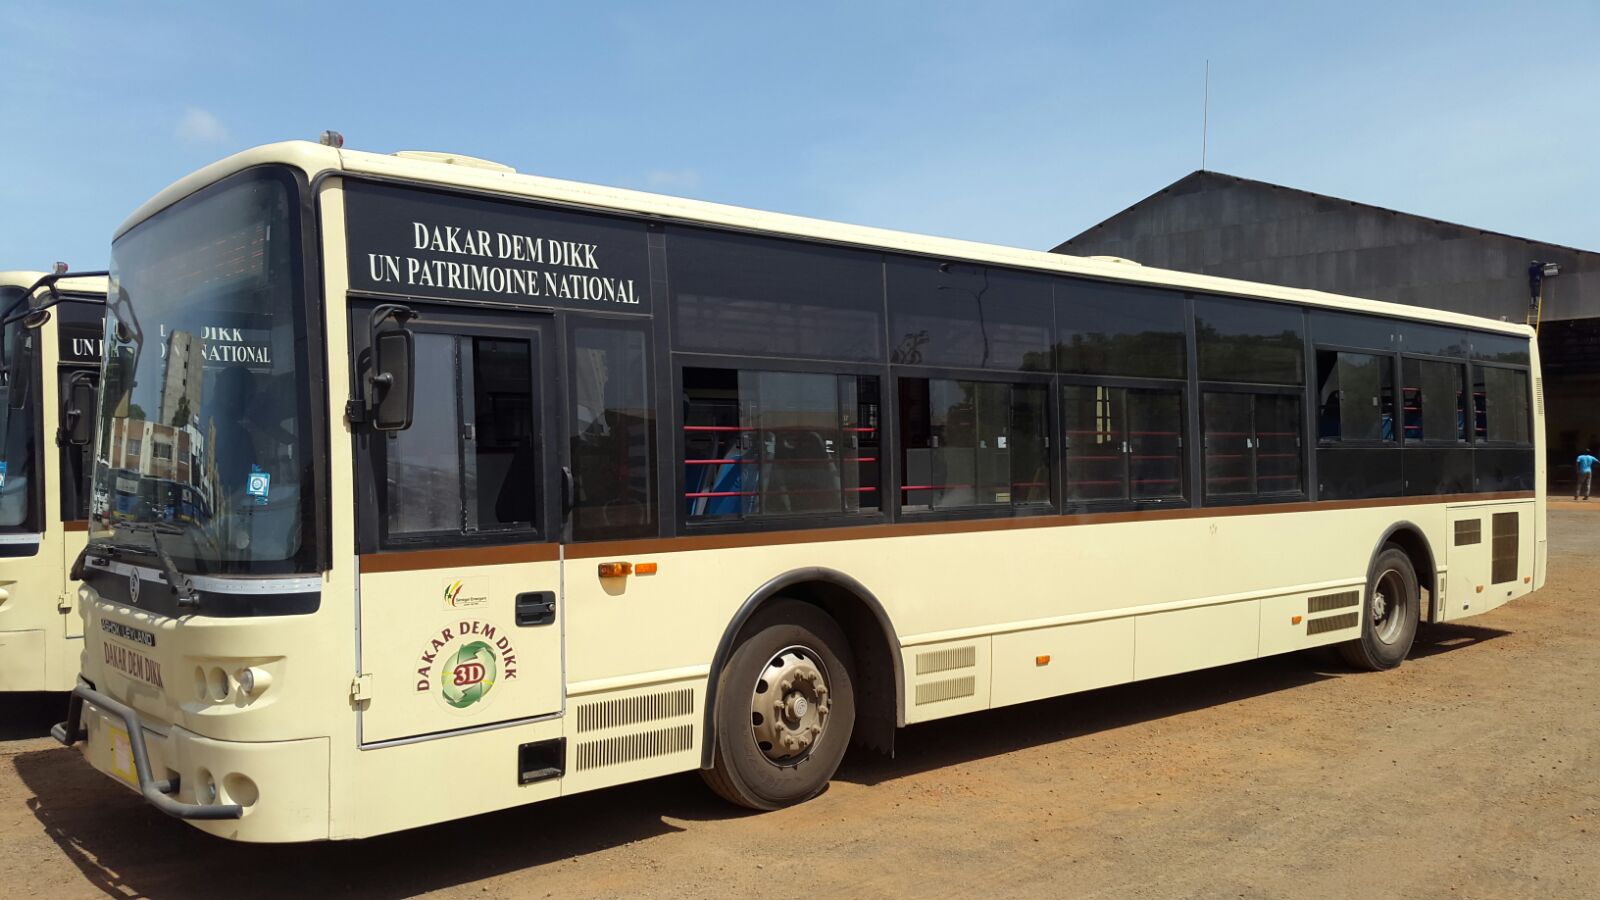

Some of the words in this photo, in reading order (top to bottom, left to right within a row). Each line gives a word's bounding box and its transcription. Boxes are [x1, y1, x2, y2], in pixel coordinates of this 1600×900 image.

[413, 221, 494, 258] DAKAR
[497, 232, 545, 264] DEM
[548, 239, 600, 270] DIKK
[368, 253, 401, 284] UN
[406, 257, 540, 296] PATRIMOINE
[544, 271, 640, 305] NATIONAL
[72, 338, 94, 357] UN
[104, 641, 127, 673] DAKAR
[128, 650, 144, 680] DEM
[145, 657, 164, 689] DIKK
[417, 628, 455, 692] DAKAR
[459, 621, 496, 641] DEM
[496, 636, 517, 681] DIKK
[454, 663, 485, 686] 3D
